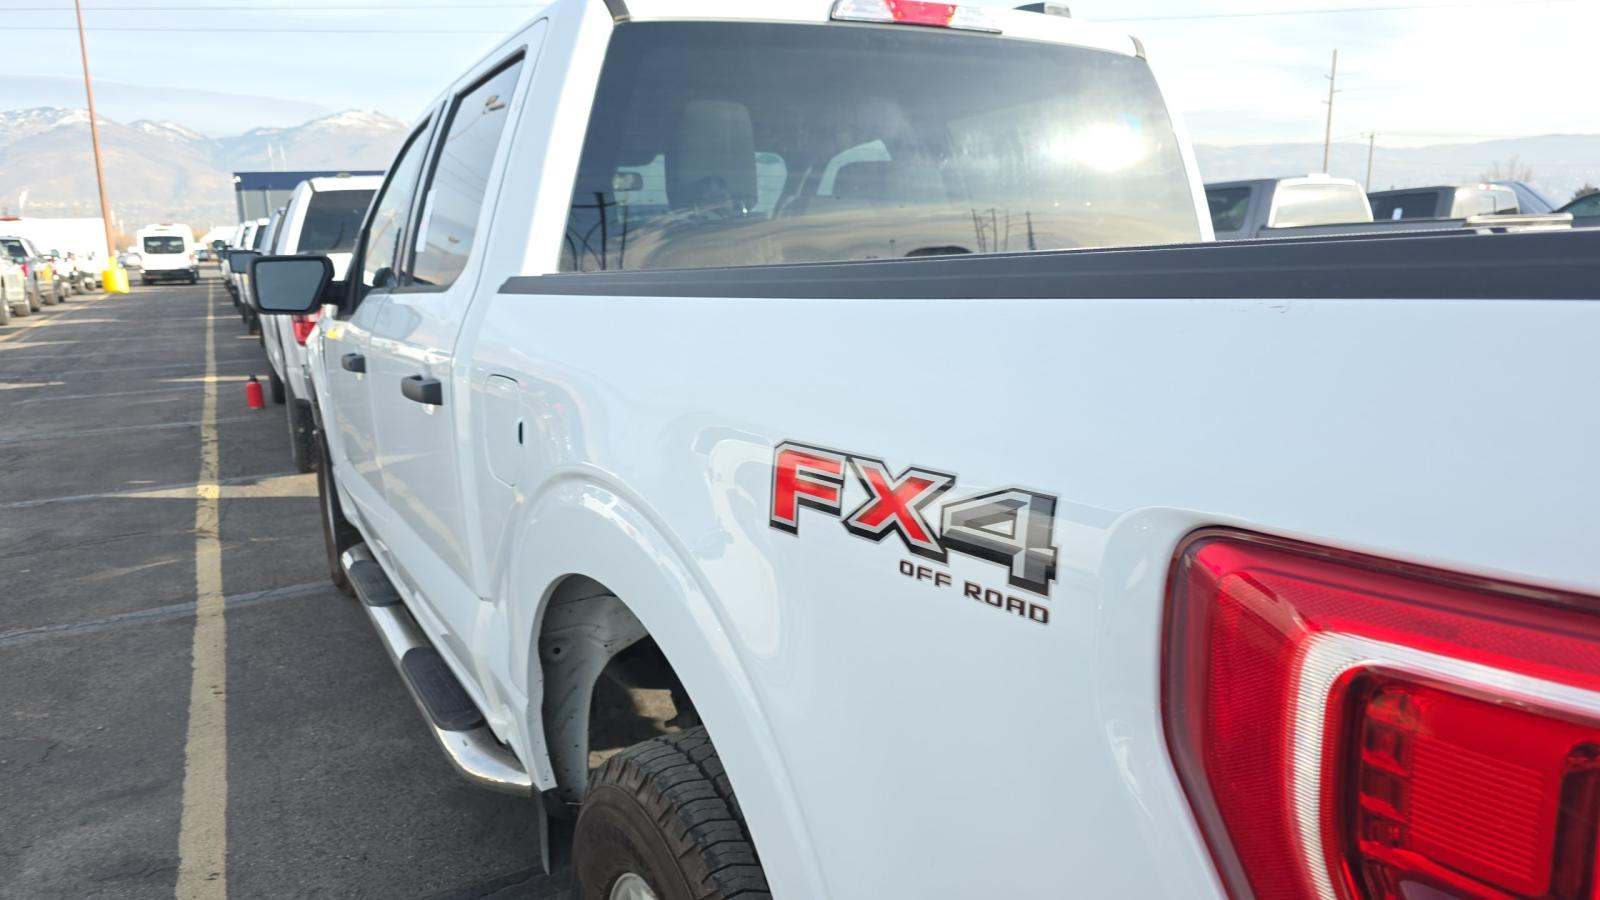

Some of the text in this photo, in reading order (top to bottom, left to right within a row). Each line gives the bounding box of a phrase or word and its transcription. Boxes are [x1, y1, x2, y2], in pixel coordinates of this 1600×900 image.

[769, 439, 1058, 597] FX4
[899, 559, 1049, 625] OFF ROAD
